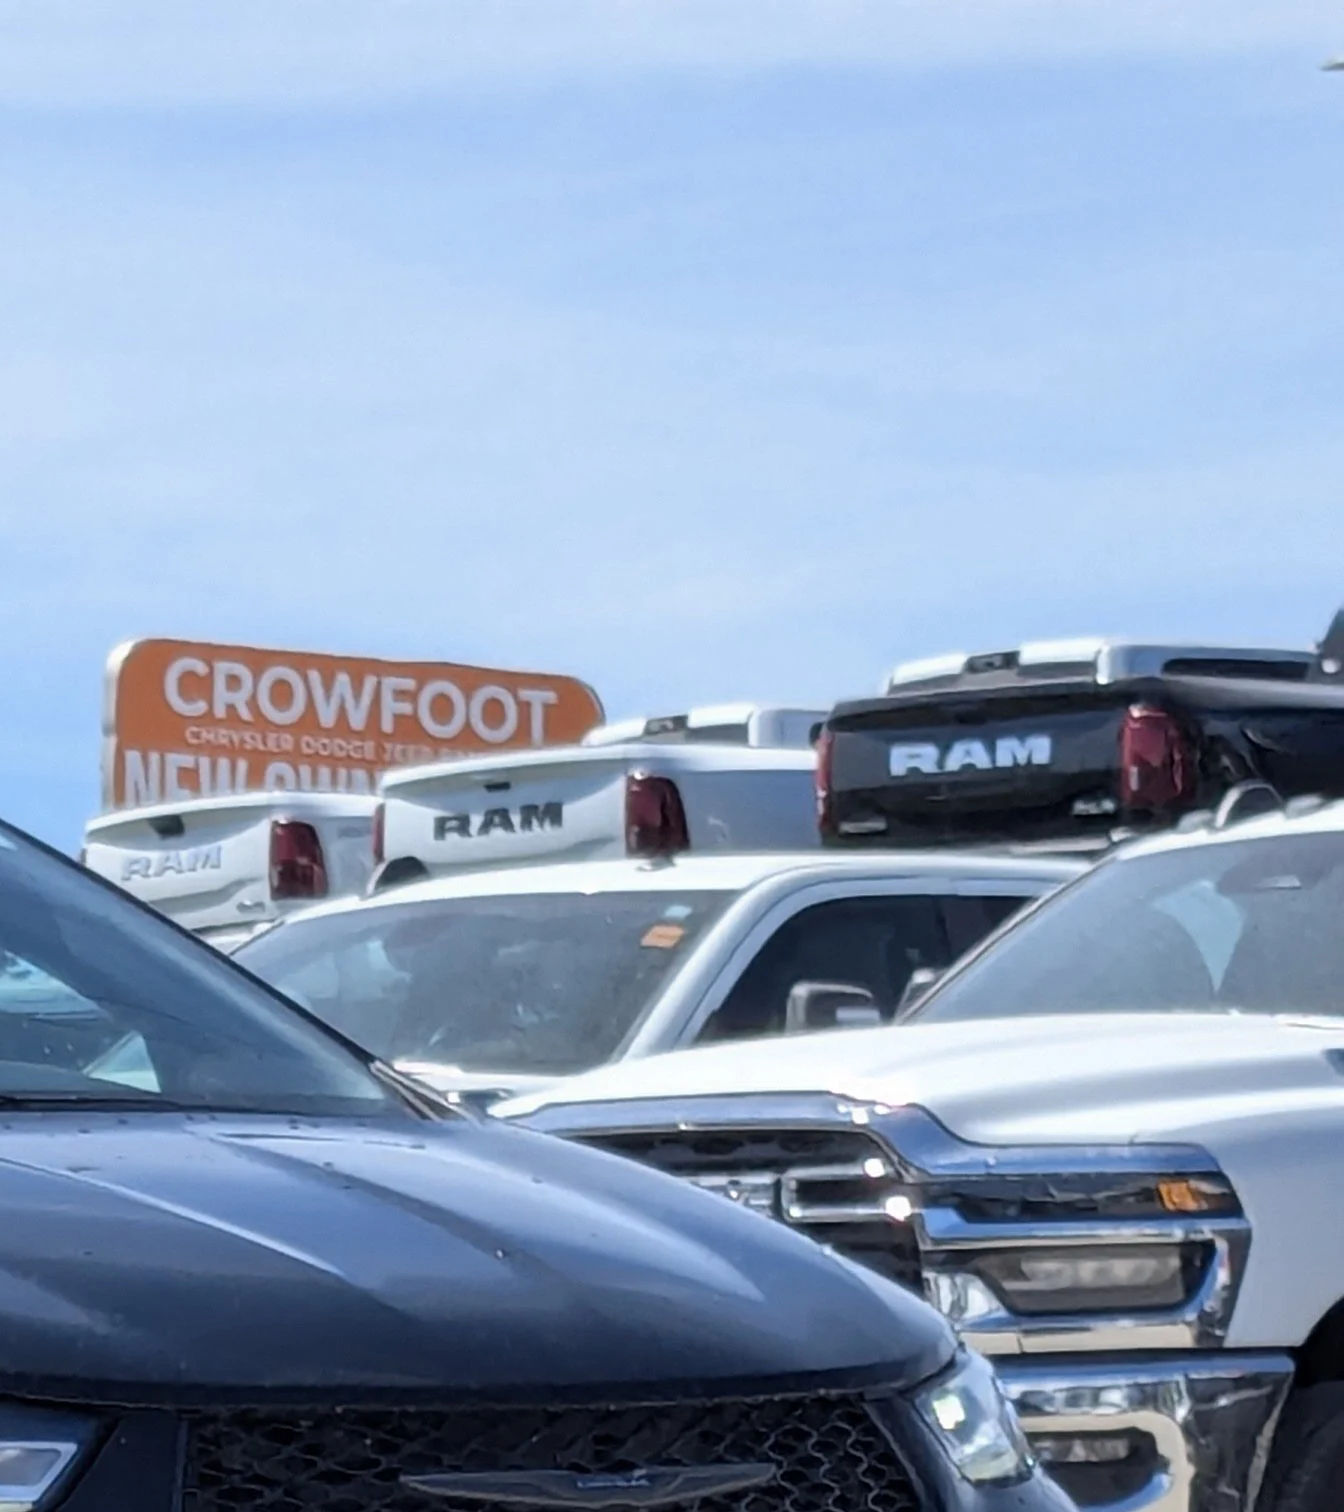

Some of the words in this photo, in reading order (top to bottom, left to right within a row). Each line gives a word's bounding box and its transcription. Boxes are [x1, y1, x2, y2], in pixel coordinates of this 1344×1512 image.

[163, 656, 559, 747] CROWFOOT
[184, 725, 296, 755] CHRYSLER
[300, 735, 377, 761] DODGE
[888, 735, 1053, 777] RAM
[123, 749, 249, 809] NEW
[431, 801, 565, 842] RAM
[119, 845, 223, 882] RAM
